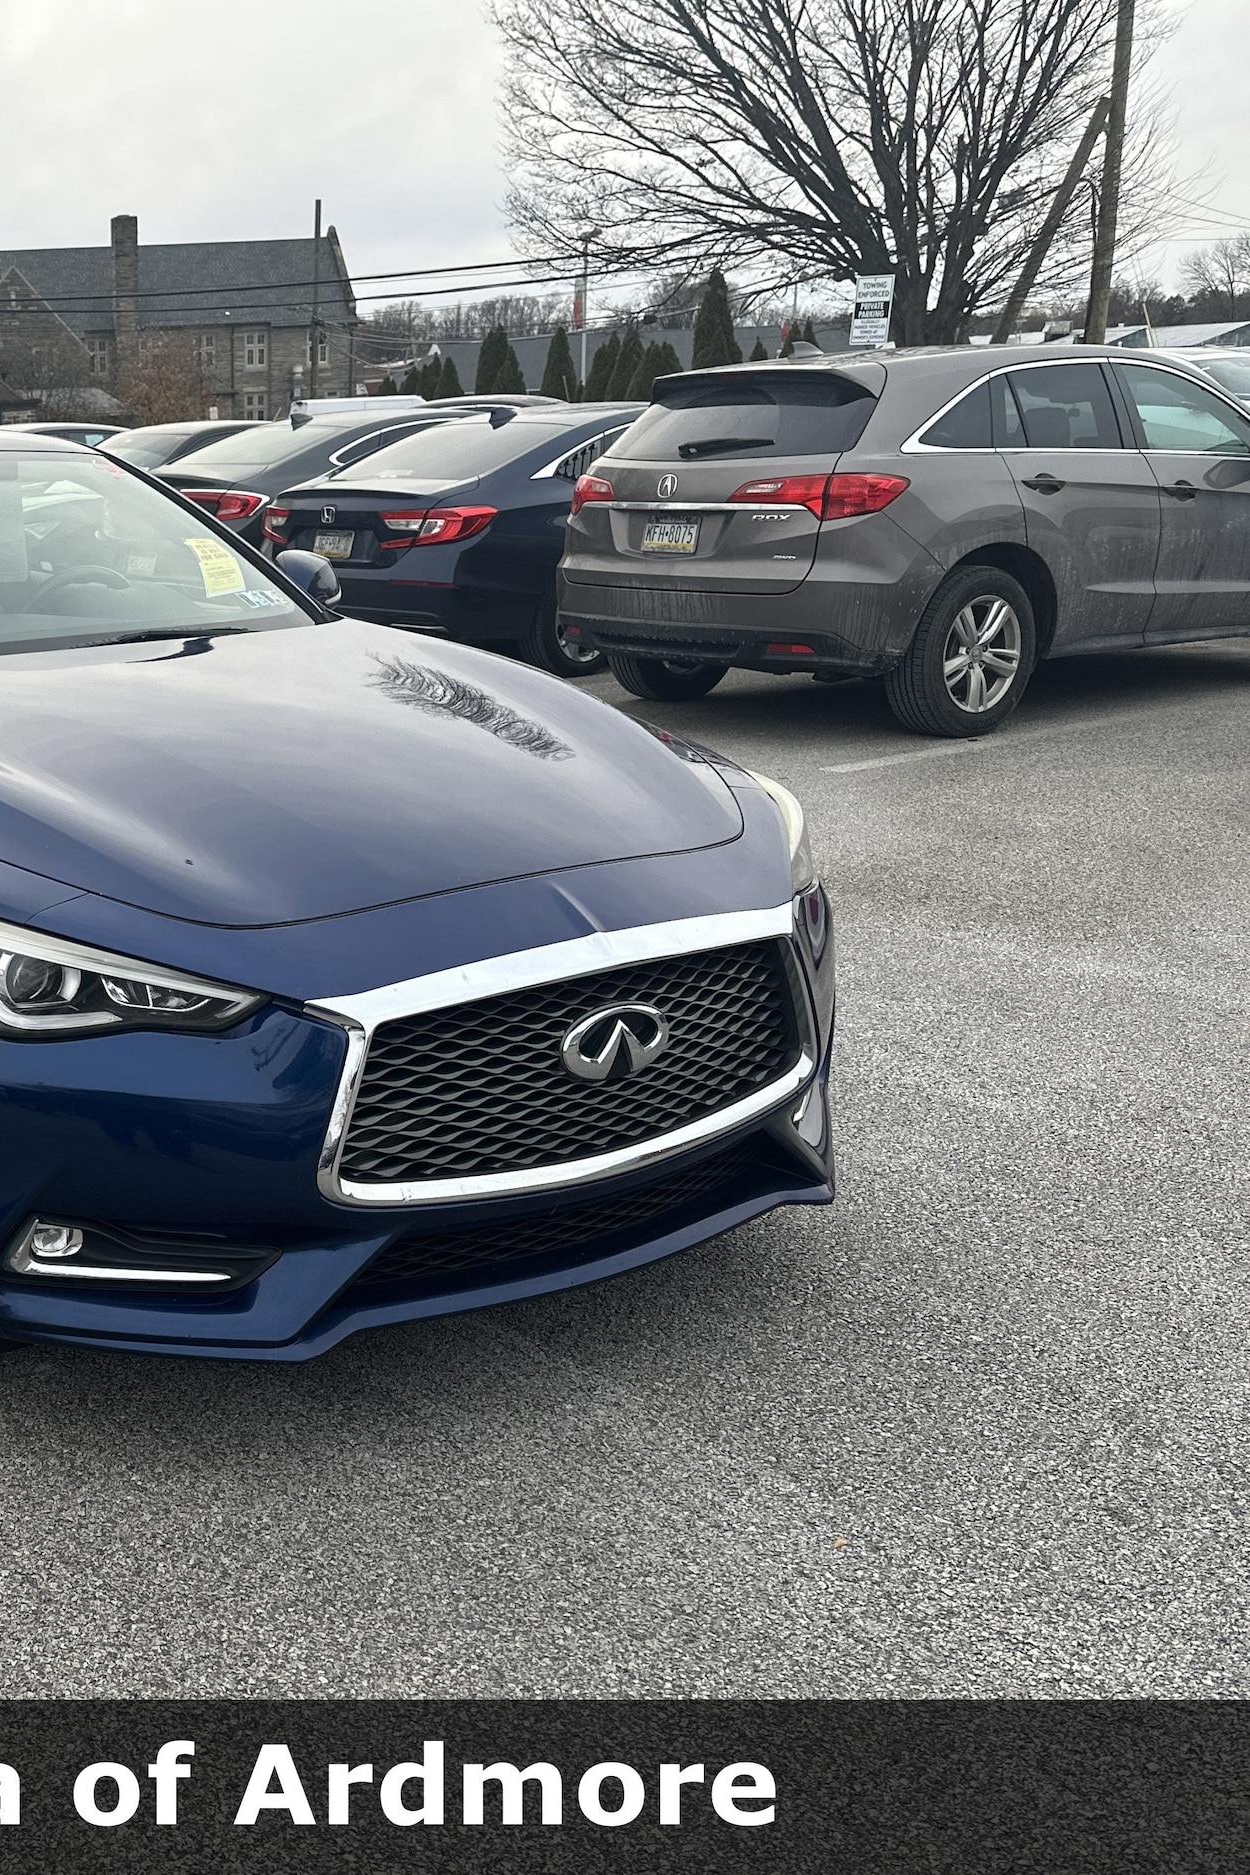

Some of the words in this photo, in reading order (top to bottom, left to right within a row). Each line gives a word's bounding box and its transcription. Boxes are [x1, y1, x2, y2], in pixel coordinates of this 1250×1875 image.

[863, 281, 887, 289] TOWING
[858, 290, 889, 298] ENFORCED
[860, 302, 885, 310] PRIVATE
[858, 310, 885, 318] PARKING
